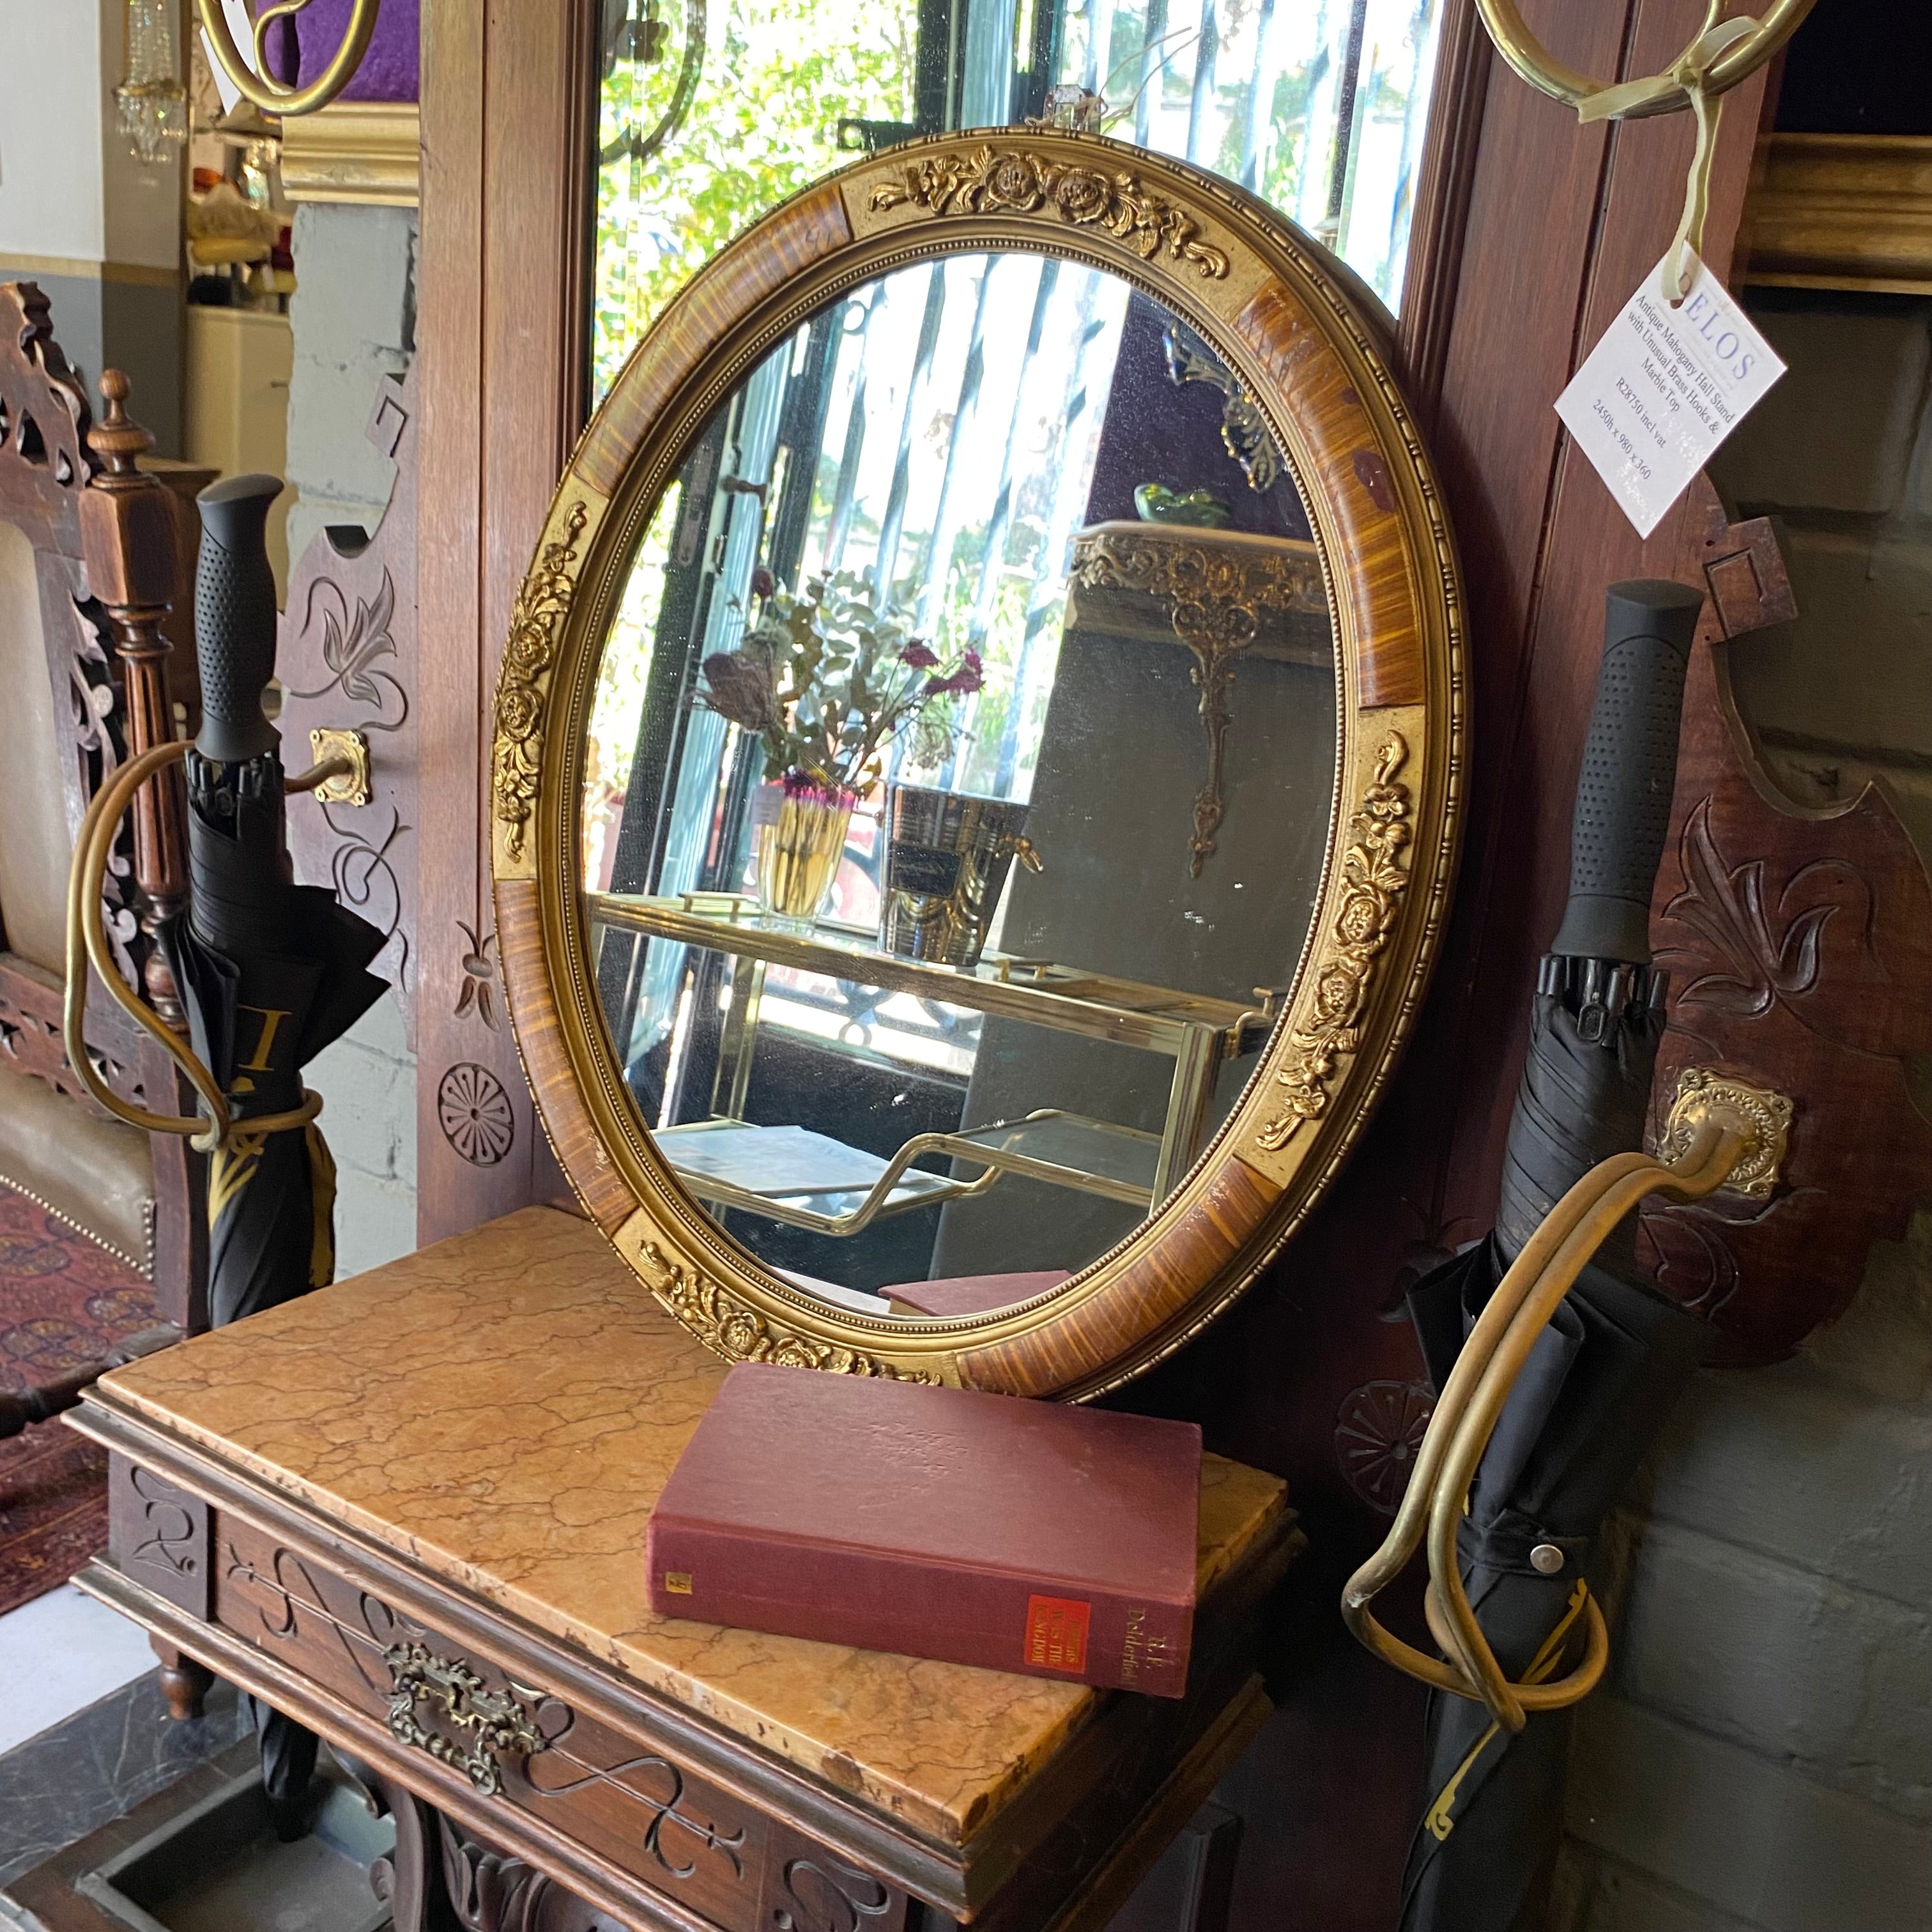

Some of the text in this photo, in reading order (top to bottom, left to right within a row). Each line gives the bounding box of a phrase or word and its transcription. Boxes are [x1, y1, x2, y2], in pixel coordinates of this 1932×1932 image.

[1629, 312, 1720, 435] with Unusual Brass Hooks &
[1636, 296, 1663, 330] Antique
[1661, 327, 1697, 376] Mahogany
[1695, 373, 1714, 397] Hall
[1710, 394, 1735, 423] Stand
[1641, 358, 1681, 413] Marble Top
[1593, 399, 1651, 479] 2450h x 980 x 360
[1616, 377, 1666, 448] R28750 incl vat
